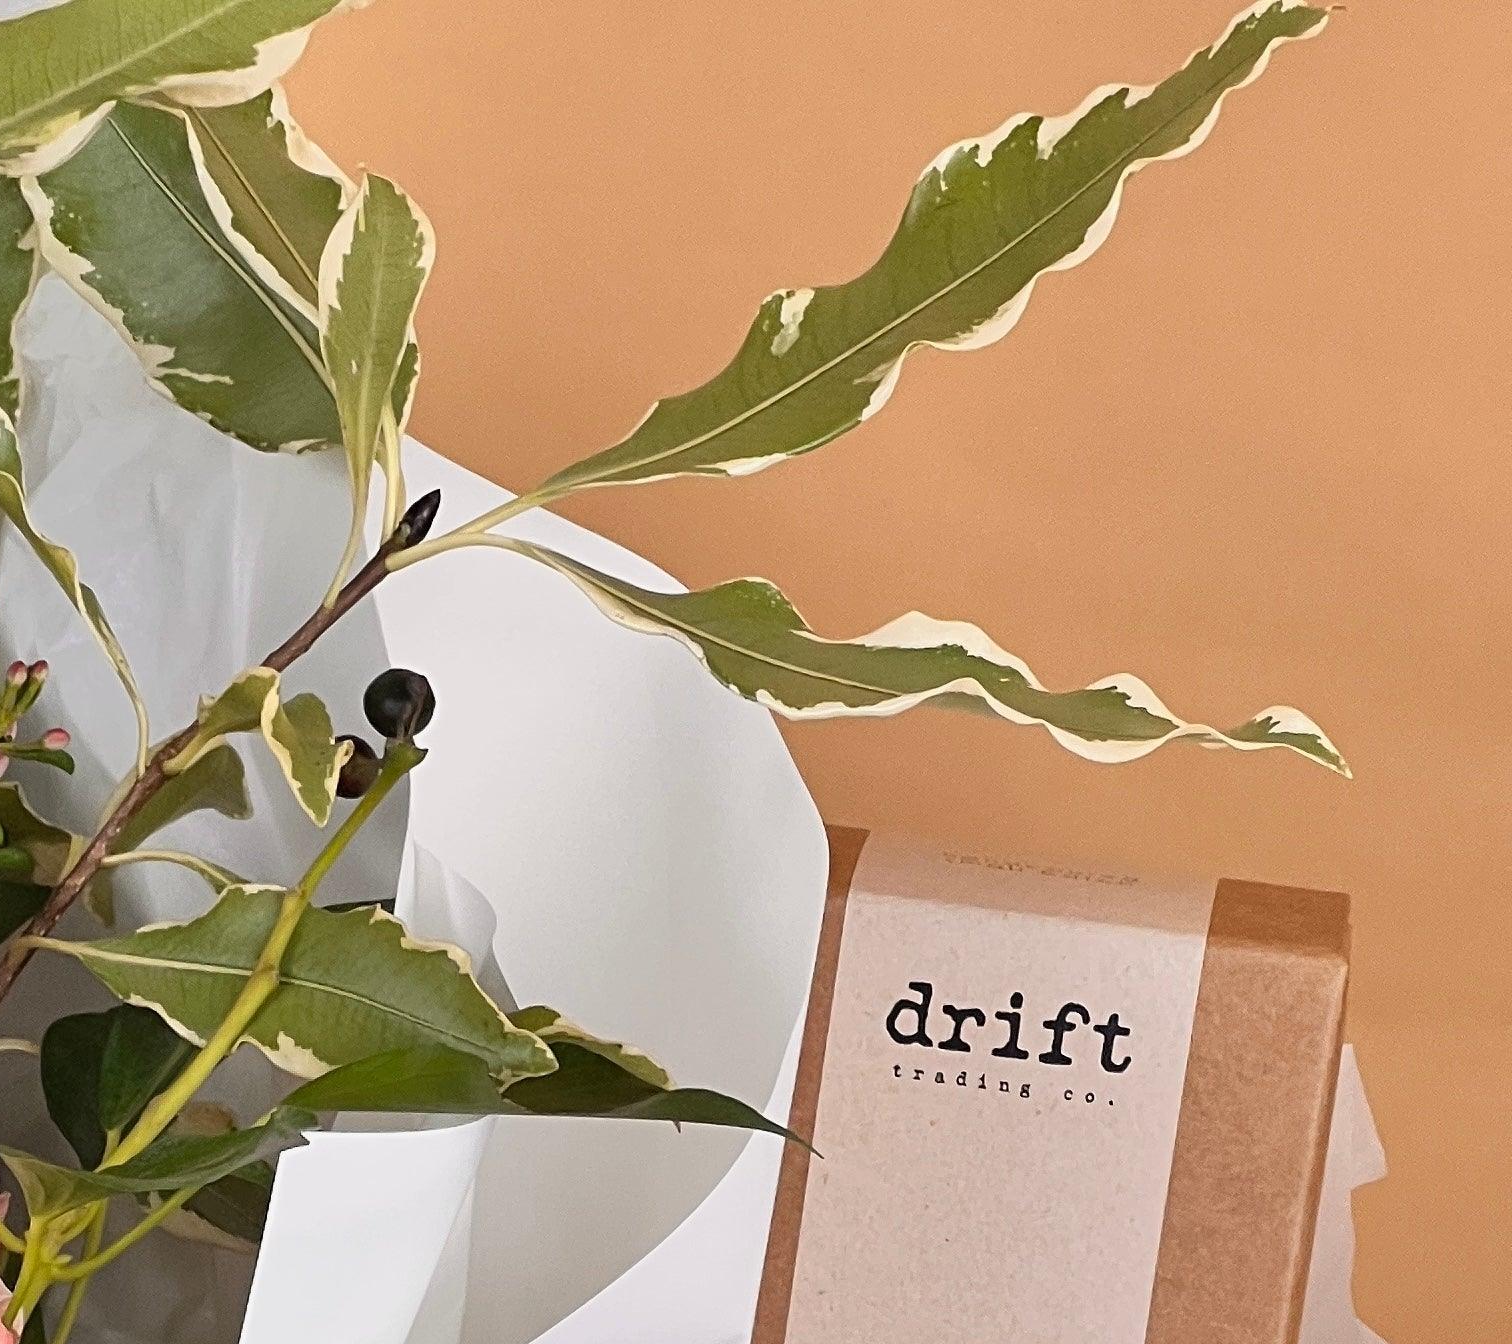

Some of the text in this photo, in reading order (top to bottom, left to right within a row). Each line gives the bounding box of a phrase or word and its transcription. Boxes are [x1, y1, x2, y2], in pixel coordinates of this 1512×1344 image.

[886, 982, 1131, 1073] drift
[892, 1063, 1116, 1106] trading co.
